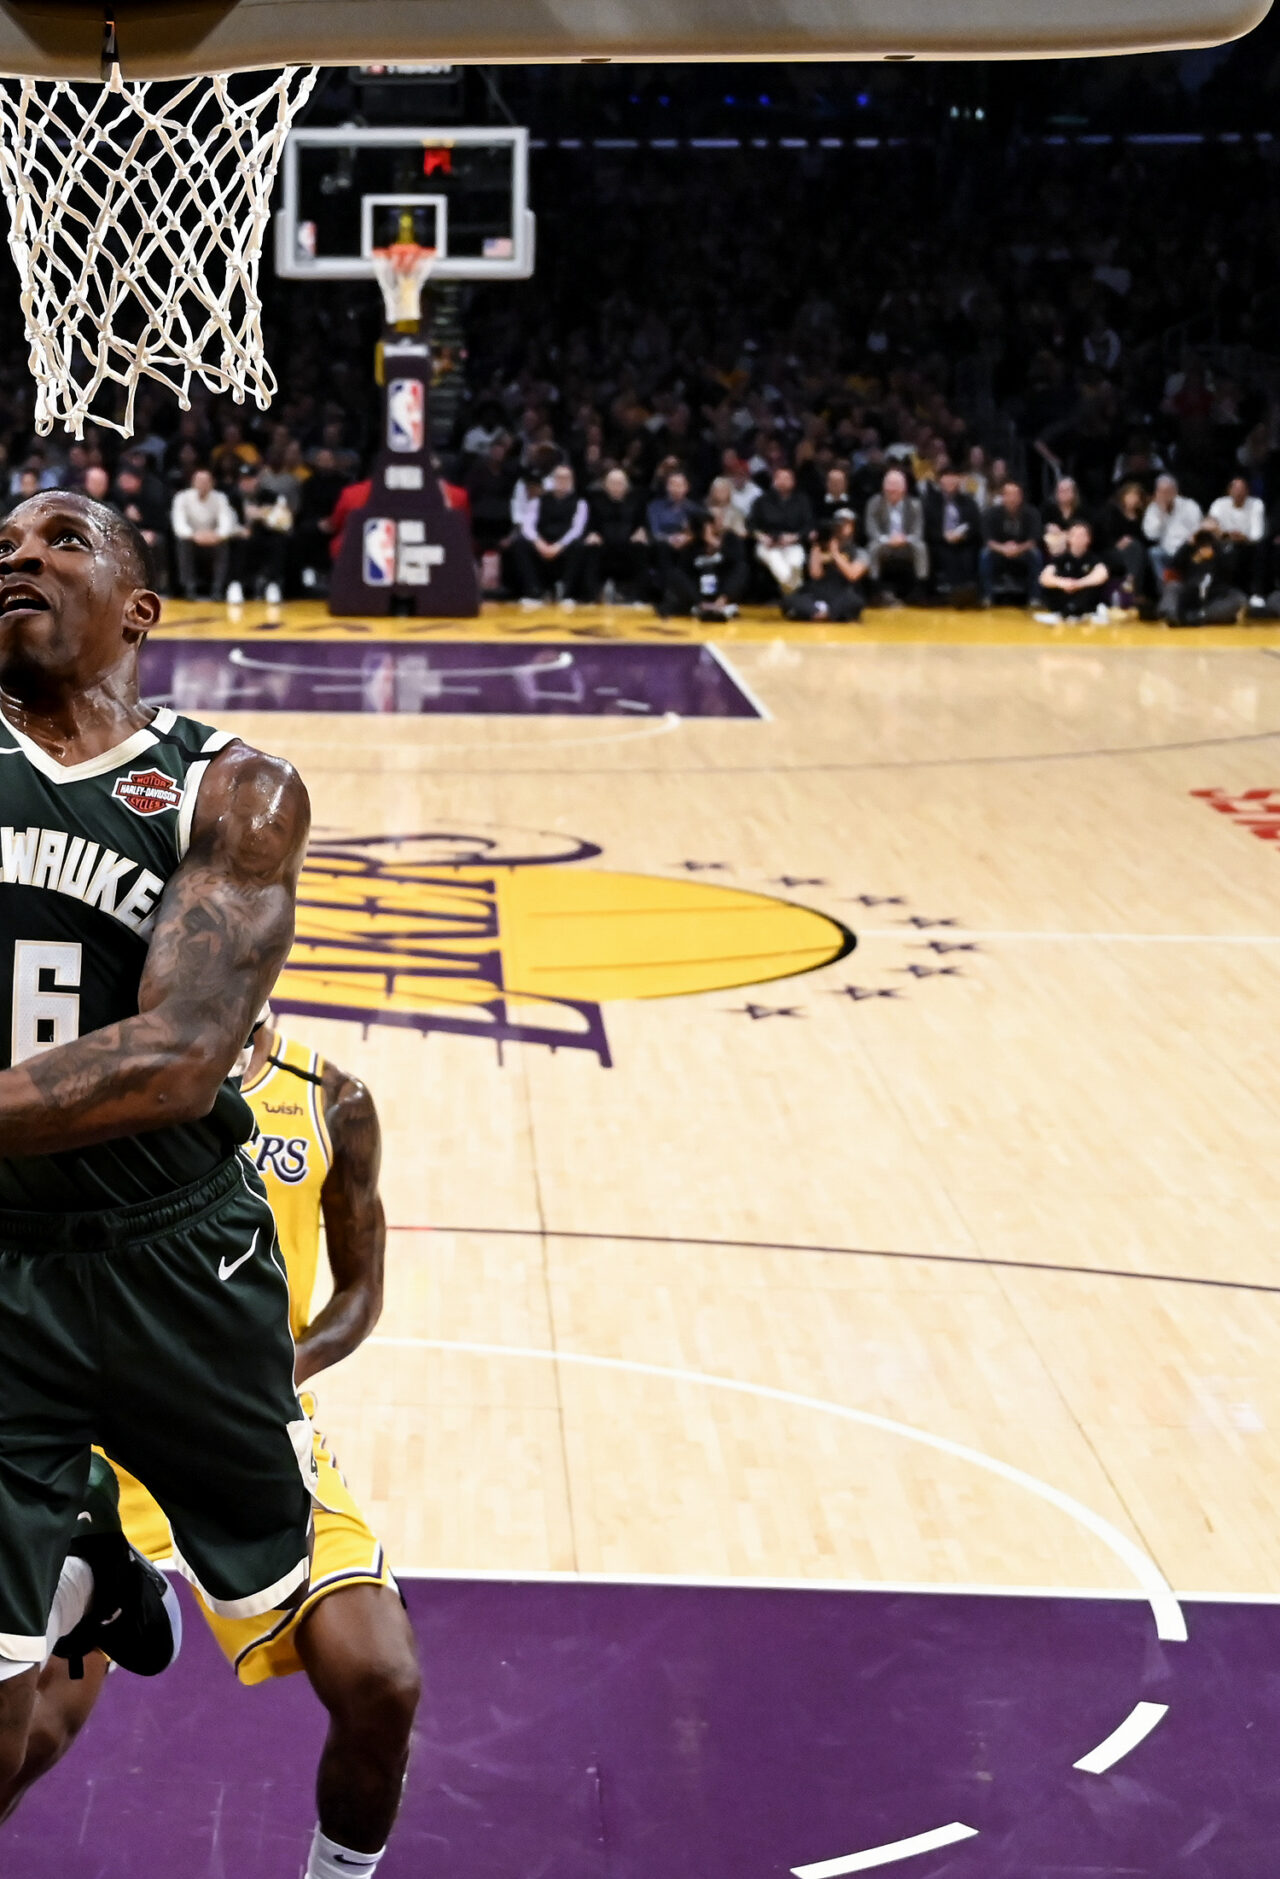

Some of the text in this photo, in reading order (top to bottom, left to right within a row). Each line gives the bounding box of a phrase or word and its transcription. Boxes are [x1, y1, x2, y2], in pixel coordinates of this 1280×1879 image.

[120, 784, 178, 803] HARLEY-DAVIDSON
[10, 939, 82, 1067] 6
[261, 1101, 304, 1116] wish
